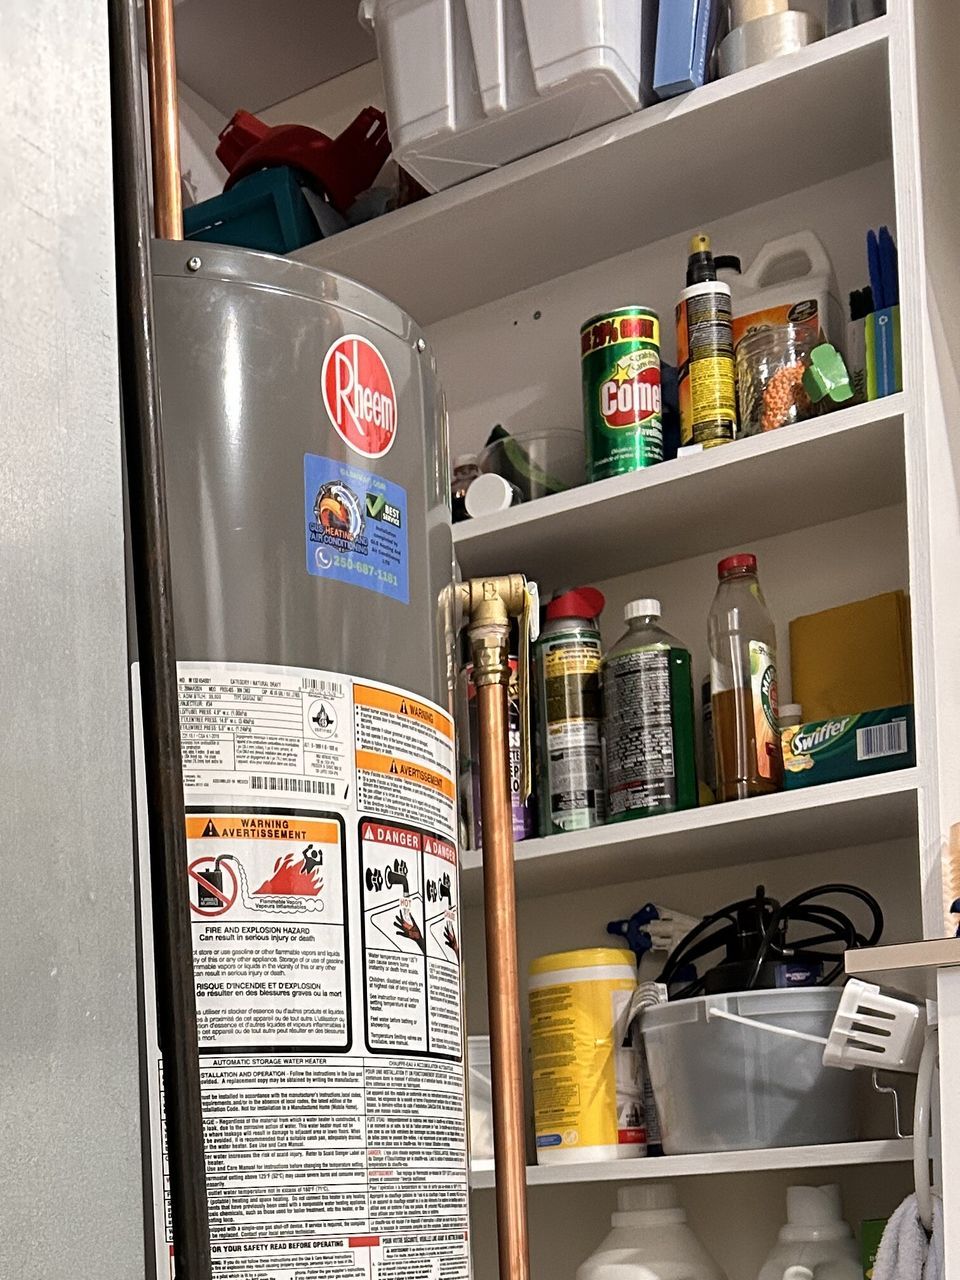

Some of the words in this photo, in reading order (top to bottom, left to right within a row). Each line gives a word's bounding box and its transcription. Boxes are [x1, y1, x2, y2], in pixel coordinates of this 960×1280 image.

[334, 340, 394, 436] Rheem
[602, 381, 662, 416] Come
[382, 512, 400, 526] SERVICE
[384, 504, 400, 519] BEST
[325, 526, 354, 541] HEATING
[310, 533, 324, 545] AIR
[324, 535, 368, 556] CONDITIONING
[410, 704, 434, 724] WARNING
[794, 718, 850, 754] Swiffer
[400, 764, 443, 788] AVERTISSEMENT
[241, 818, 289, 829] WARNING
[222, 829, 306, 839] AVERTISSEMENT
[378, 829, 418, 848] DANGER
[313, 1240, 343, 1248] OPERATING
